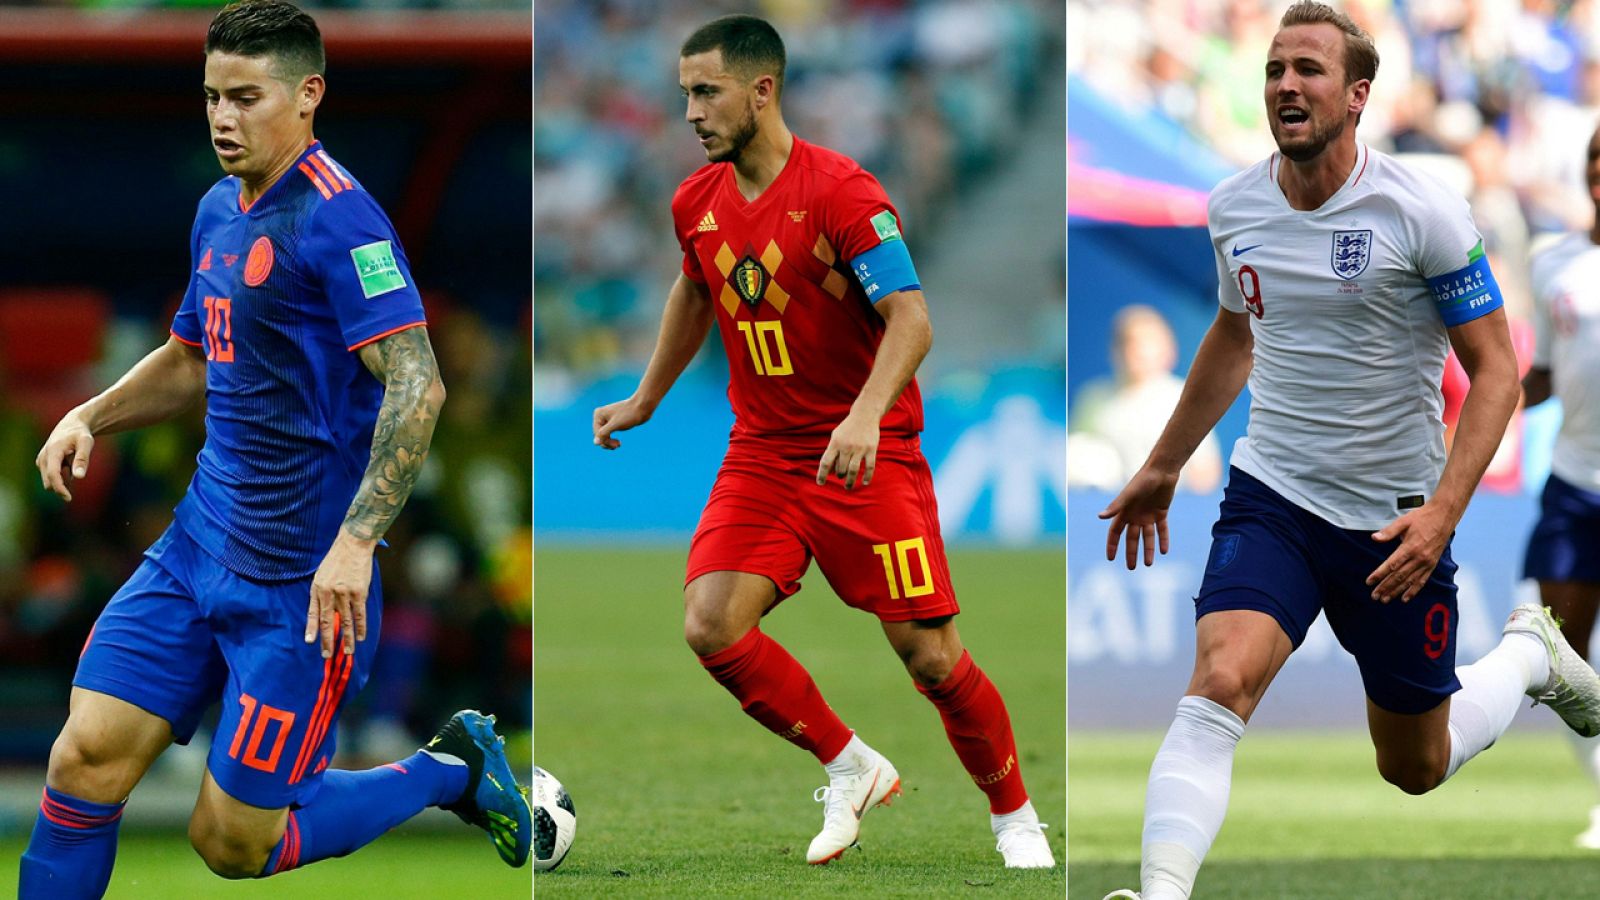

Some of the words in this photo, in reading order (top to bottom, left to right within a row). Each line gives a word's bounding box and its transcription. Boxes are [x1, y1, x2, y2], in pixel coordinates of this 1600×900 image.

[1238, 264, 1264, 319] 9
[1432, 269, 1482, 294] IVING
[1469, 293, 1493, 309] FIFA
[203, 296, 235, 362] 10
[737, 320, 794, 376] 10
[872, 536, 935, 600] 10
[1424, 602, 1450, 660] 9
[228, 693, 296, 774] 10
